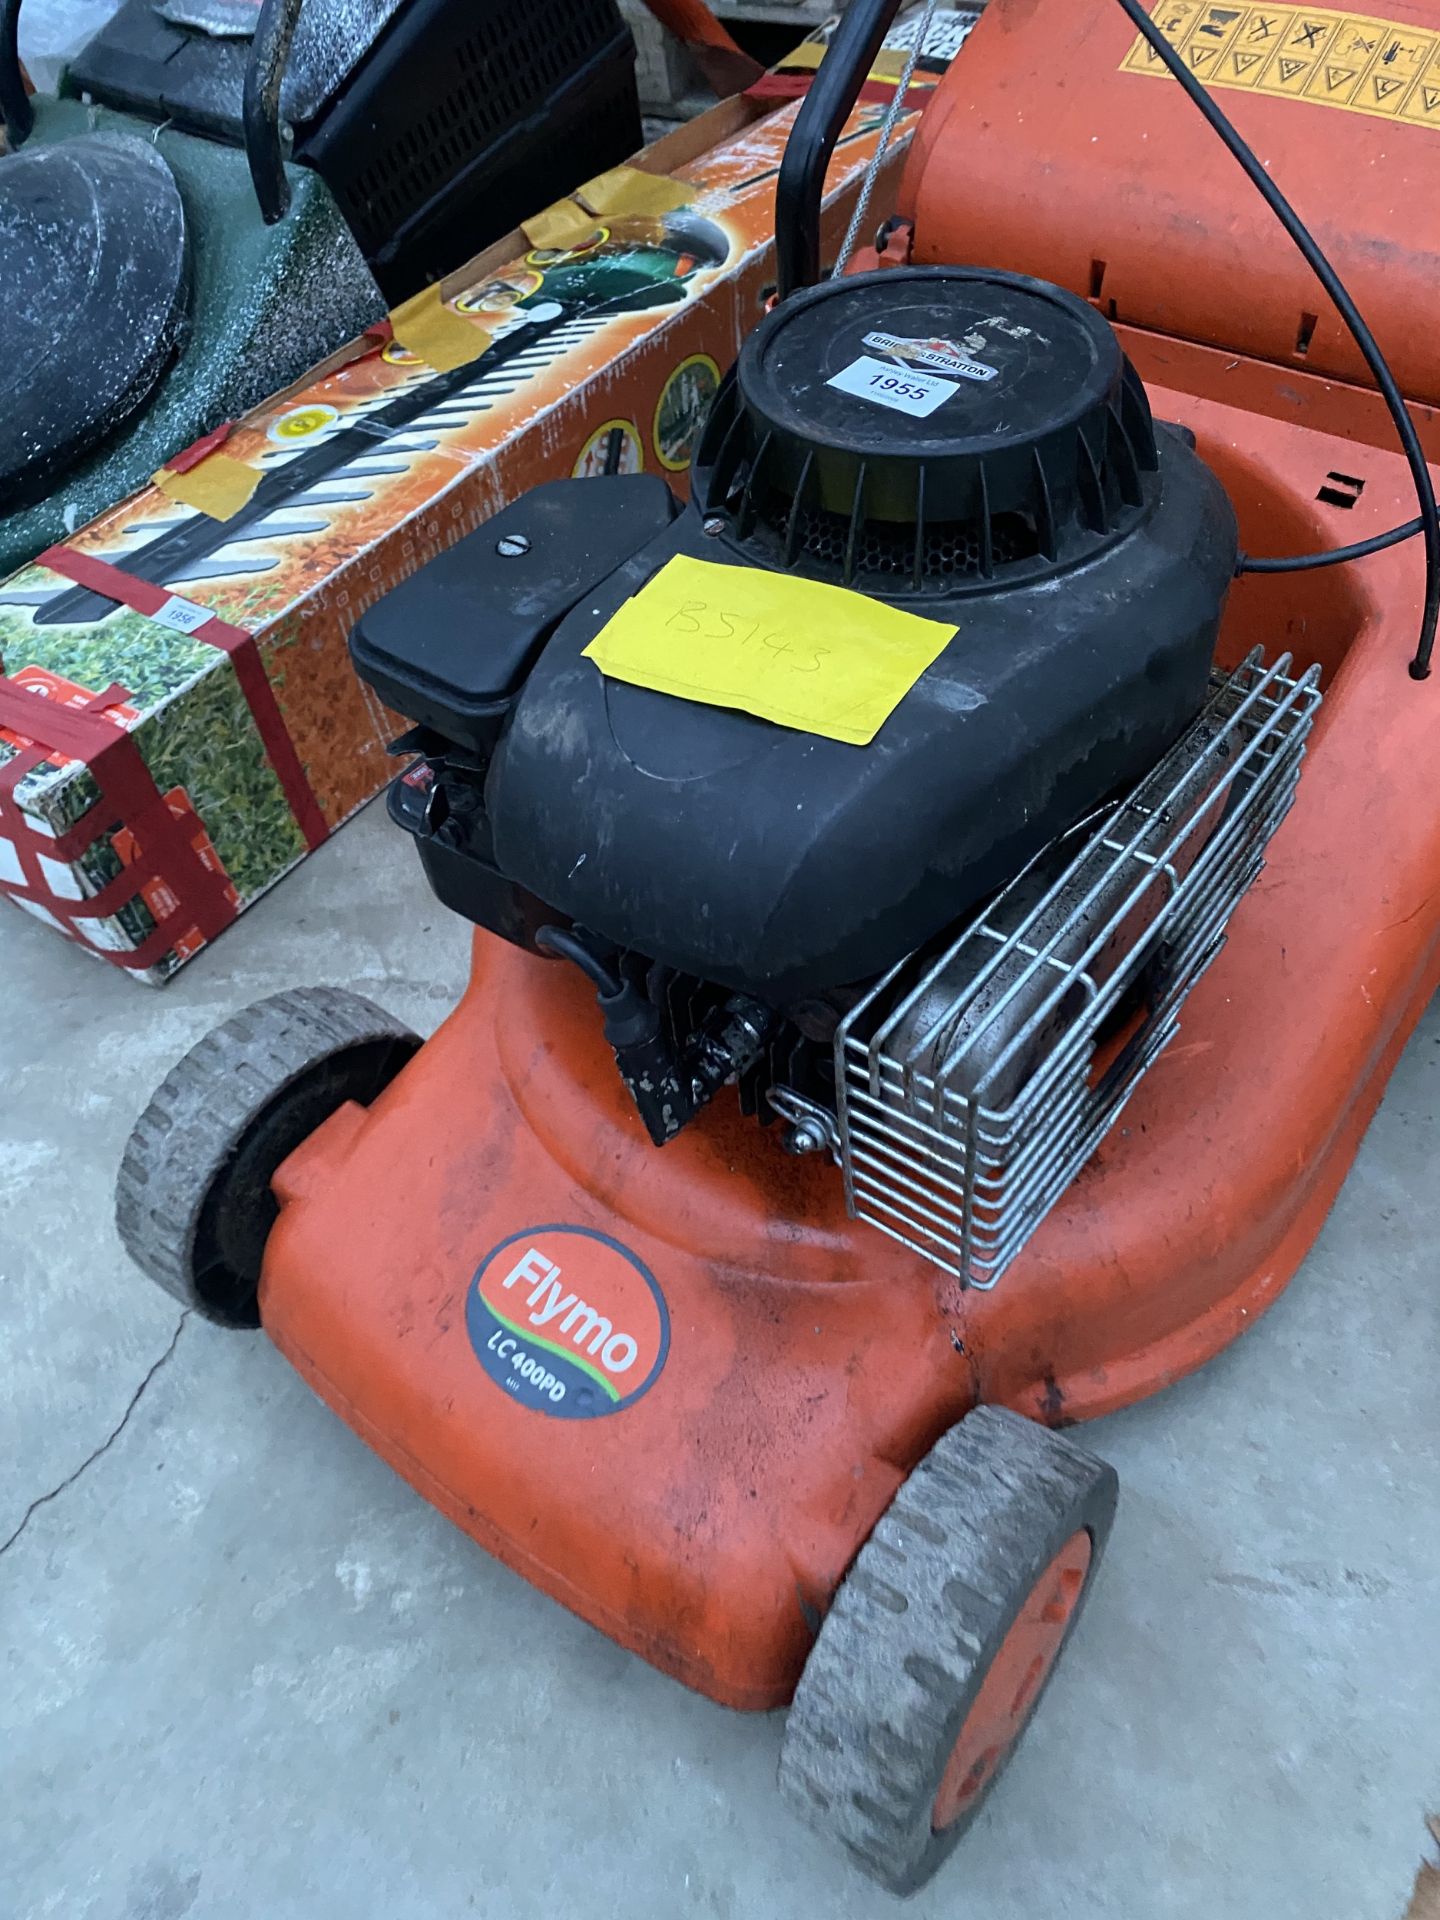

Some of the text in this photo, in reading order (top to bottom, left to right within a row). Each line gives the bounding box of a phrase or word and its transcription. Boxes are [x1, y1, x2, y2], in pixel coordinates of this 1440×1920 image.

[928, 352, 988, 377] STRATTON
[868, 374, 930, 400] 1955
[168, 609, 196, 625] 1956
[502, 1247, 638, 1373] Flymo
[487, 1329, 567, 1403] LC 400PD
